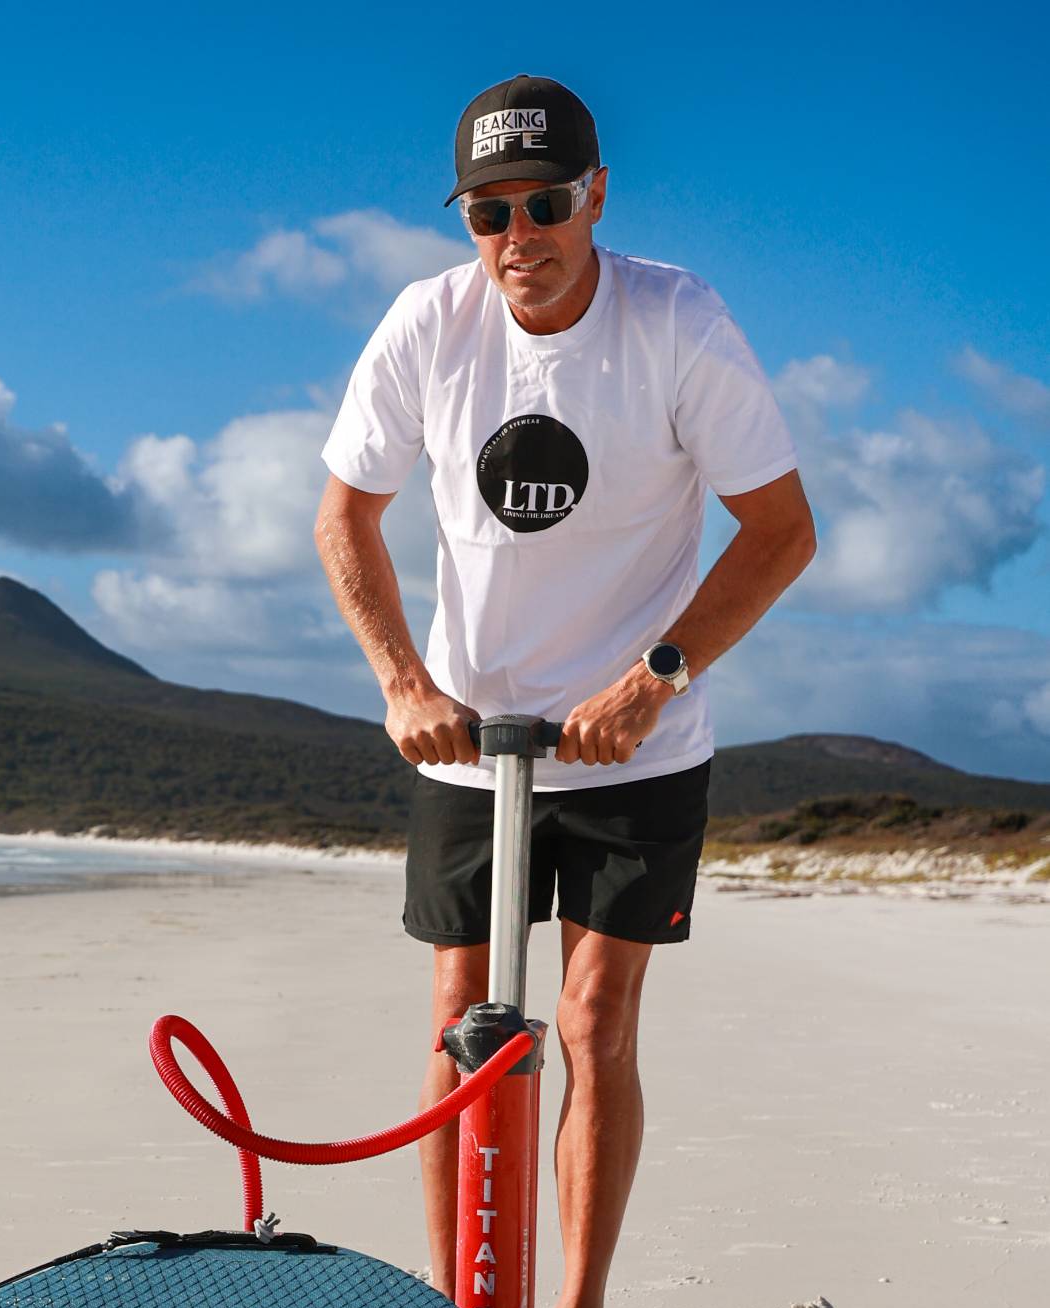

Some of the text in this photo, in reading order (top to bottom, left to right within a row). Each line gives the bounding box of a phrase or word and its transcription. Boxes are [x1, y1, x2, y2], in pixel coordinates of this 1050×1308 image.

[474, 111, 544, 139] PEAKING
[472, 132, 548, 161] LIFE
[502, 479, 575, 512] LTD
[503, 509, 525, 519] LIVING
[540, 511, 565, 519] DREAM
[473, 1147, 500, 1296] TITAN
[520, 1240, 529, 1290] TITAN
